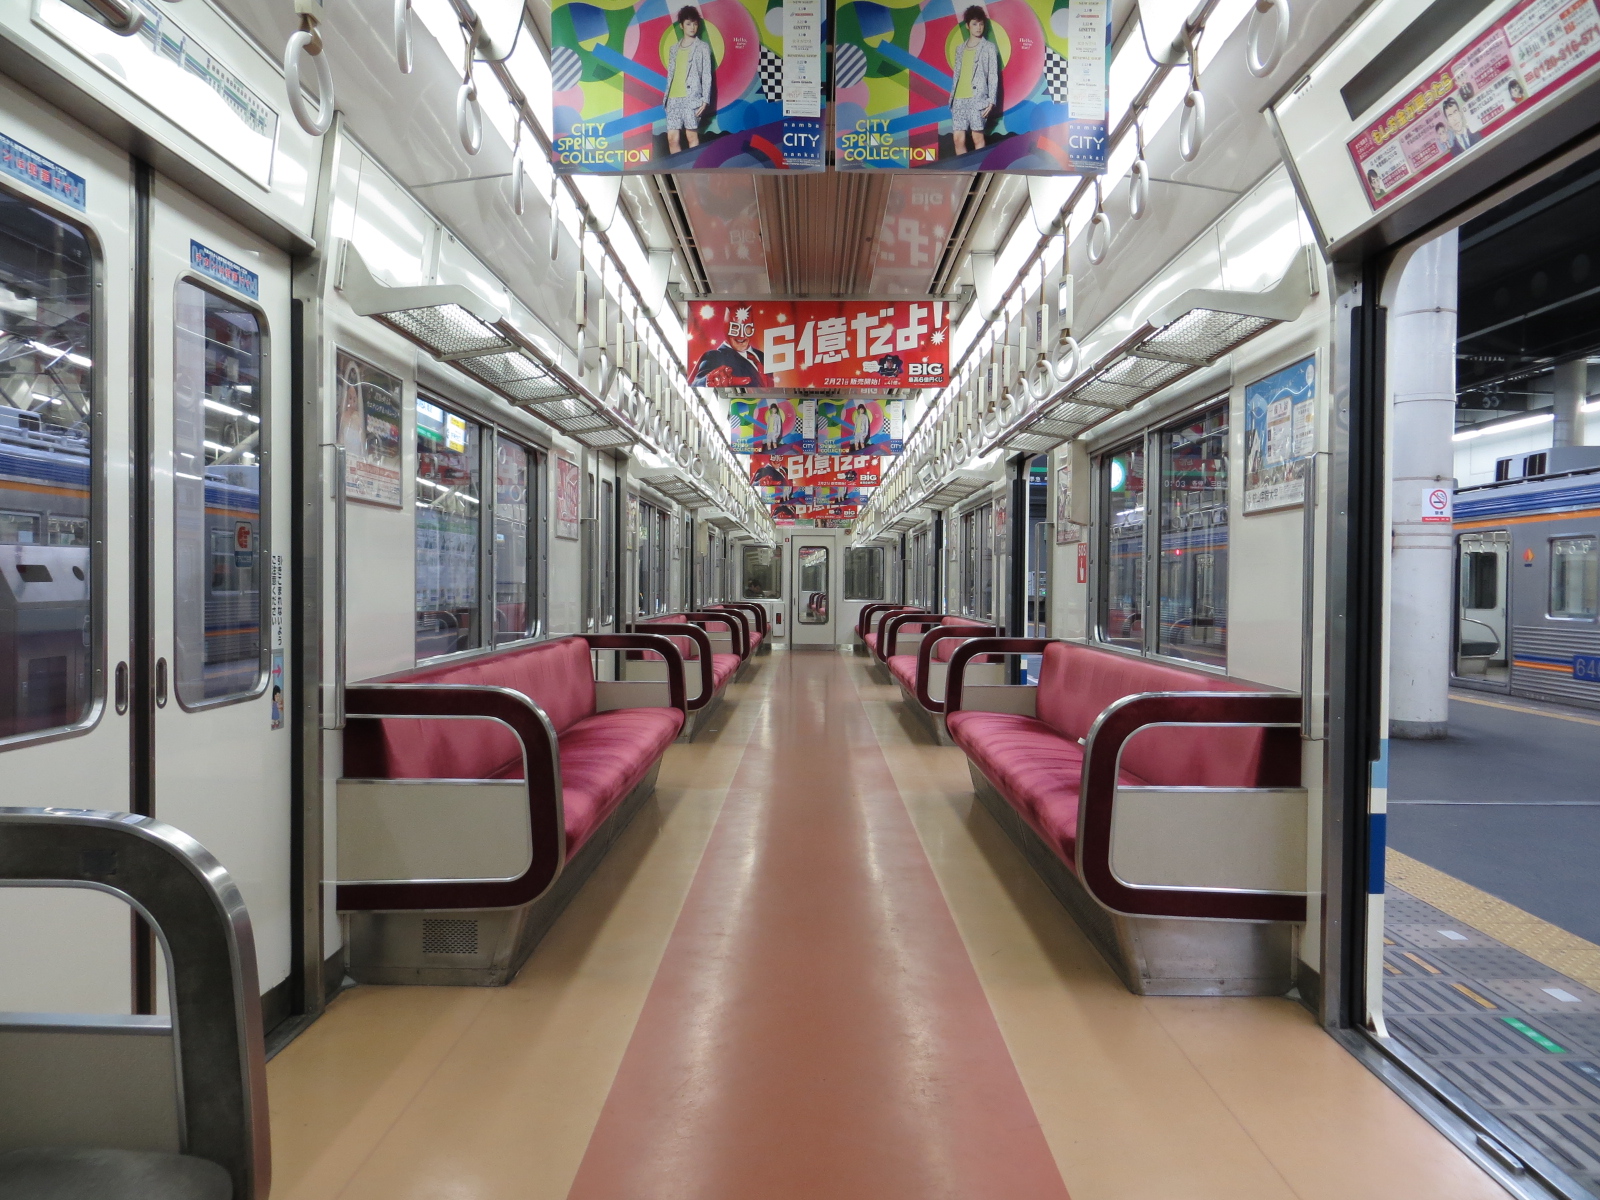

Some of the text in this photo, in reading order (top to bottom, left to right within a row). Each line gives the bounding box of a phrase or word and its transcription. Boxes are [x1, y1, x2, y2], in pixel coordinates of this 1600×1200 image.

[571, 123, 606, 136] CITY
[856, 119, 891, 132] CITY
[558, 137, 609, 151] SPRING
[783, 133, 820, 147] CITY
[842, 133, 894, 147] SPRING
[1069, 135, 1104, 150] CITY
[560, 149, 650, 164] COLLECTION
[844, 146, 935, 161] COLLECTION
[728, 321, 755, 337] BIG
[763, 301, 949, 374] 6億だよ!
[908, 360, 943, 375] BIG
[860, 473, 877, 481] BIG
[1078, 545, 1087, 556] SOS
